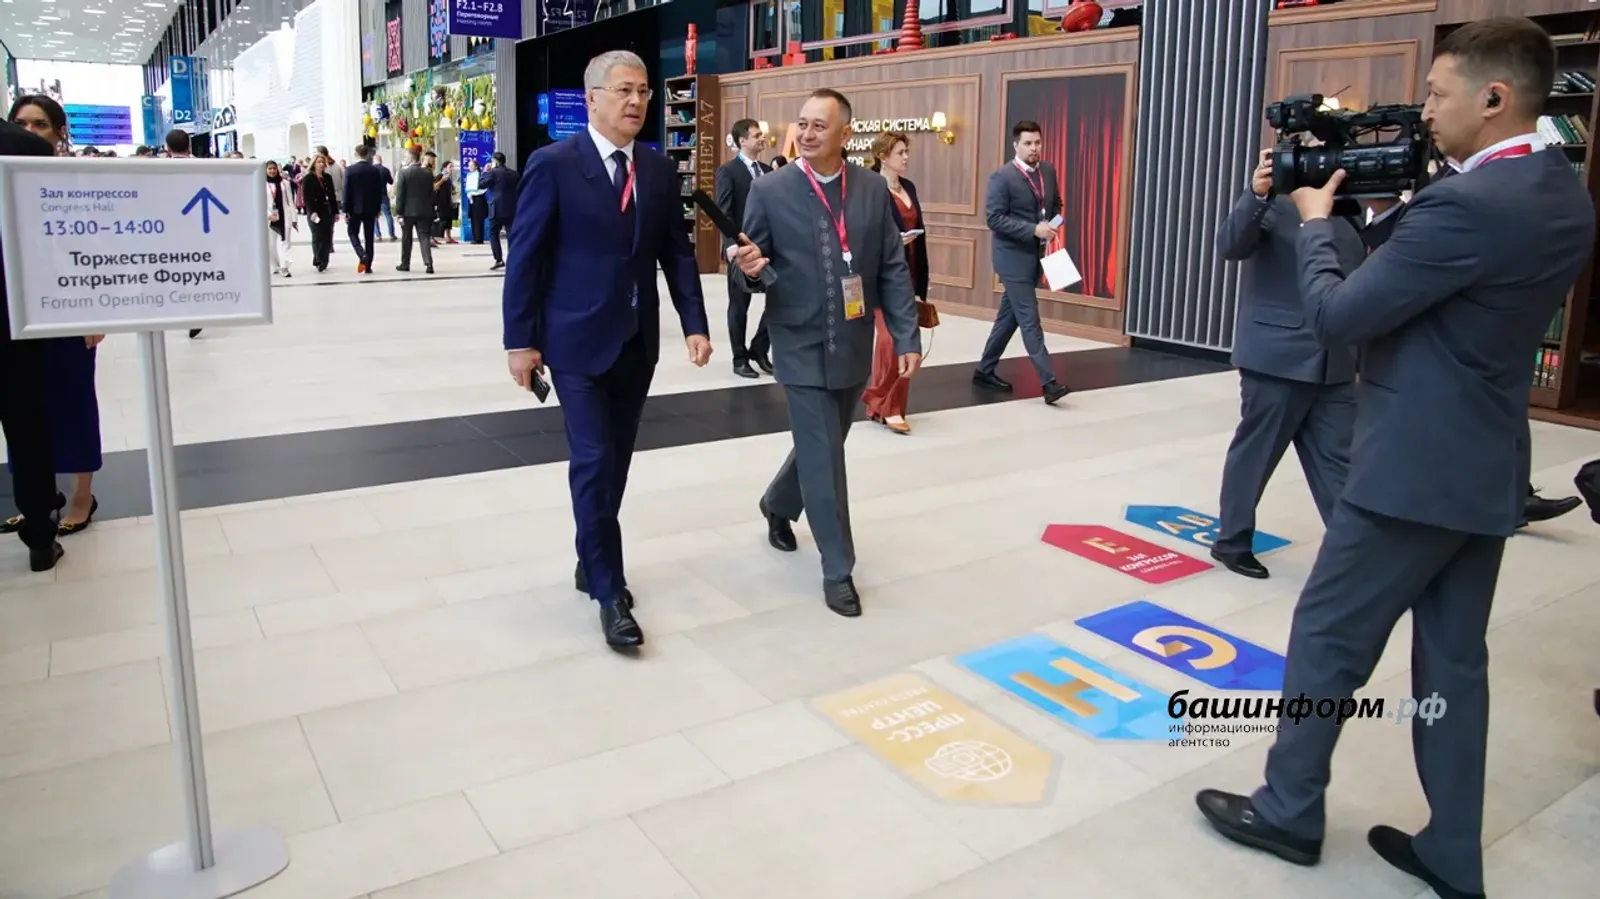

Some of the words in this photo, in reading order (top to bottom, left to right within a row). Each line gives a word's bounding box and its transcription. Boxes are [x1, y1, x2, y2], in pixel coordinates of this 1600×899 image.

[173, 59, 187, 74] D
[174, 110, 191, 120] D2
[882, 117, 930, 132] СИСТЕМА
[700, 132, 714, 231] КИНЕТ
[40, 188, 63, 199] Зал
[67, 189, 139, 201] конгрессов
[41, 202, 90, 213] Congress
[93, 202, 114, 212] Hall
[69, 250, 212, 268] Торжественное
[58, 271, 149, 289] открытие
[154, 268, 225, 286] Форума
[41, 296, 93, 310] Forum
[99, 292, 164, 308] Opening
[169, 290, 241, 304] Ceremony
[1081, 537, 1131, 555] E
[1131, 625, 1237, 670] G
[1010, 658, 1141, 718] H
[871, 700, 943, 730] ЦЕНТР
[886, 712, 966, 742] ПРЕСС-
